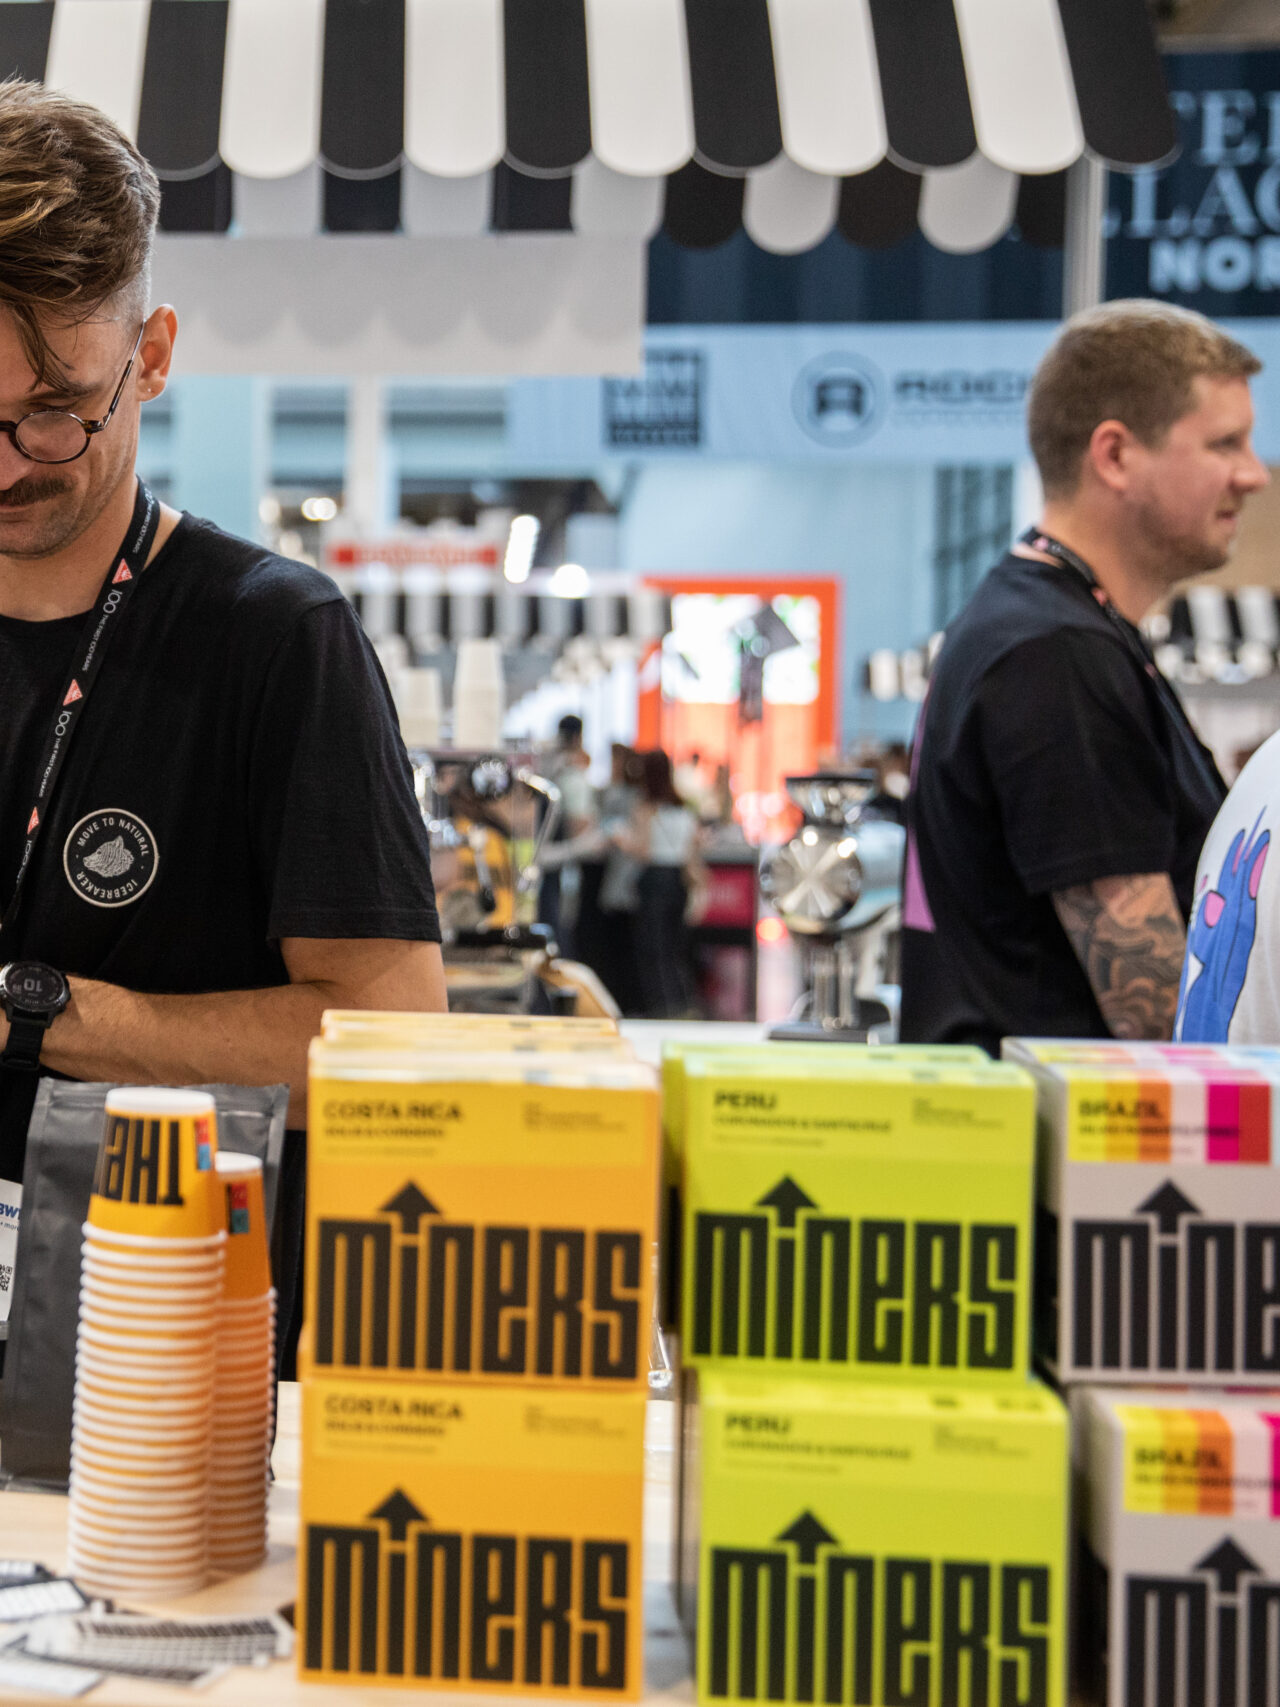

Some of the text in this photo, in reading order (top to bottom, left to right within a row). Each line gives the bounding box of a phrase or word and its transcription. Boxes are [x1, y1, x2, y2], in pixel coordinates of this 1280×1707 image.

[102, 589, 123, 614] 100
[54, 710, 73, 736] 100
[77, 817, 150, 856] MOVE TO NATURAL
[76, 871, 138, 899] ICEBREAKER
[323, 1101, 464, 1121] COSTA RICA
